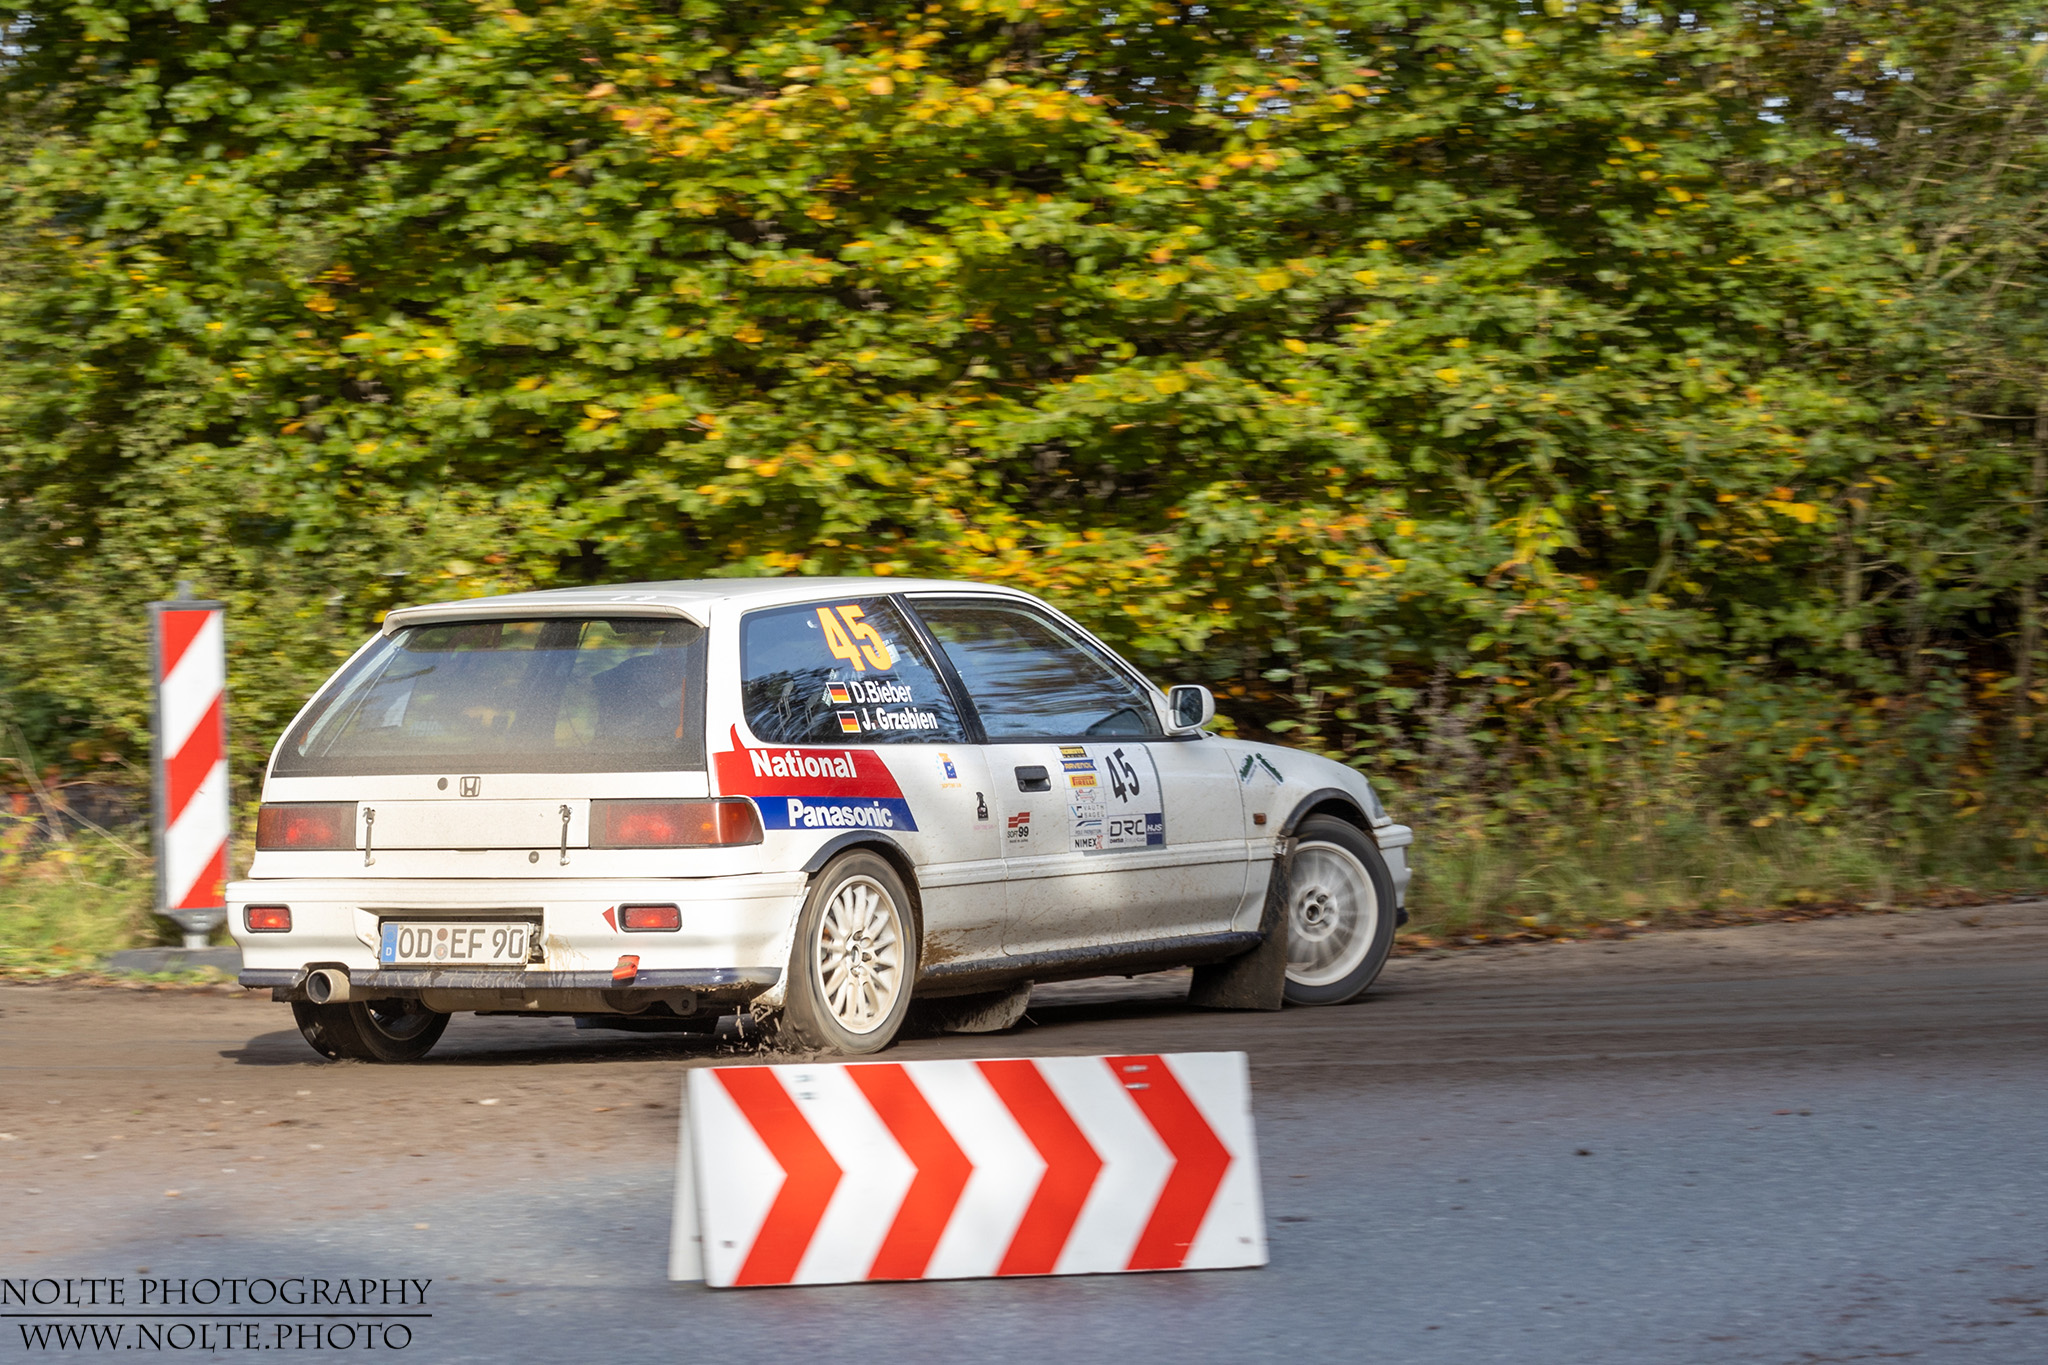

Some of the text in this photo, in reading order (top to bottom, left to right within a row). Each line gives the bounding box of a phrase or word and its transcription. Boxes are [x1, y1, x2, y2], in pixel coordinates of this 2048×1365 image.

[816, 604, 892, 671] 45
[849, 681, 913, 703] D.Bieber
[862, 707, 938, 731] J. Grzebien
[749, 750, 857, 778] National
[1105, 748, 1139, 803] 45
[787, 798, 893, 828] Panasonic
[1110, 820, 1145, 837] DRC
[1147, 823, 1163, 831] HJS
[385, 947, 392, 956] D
[399, 928, 524, 958] OD EF 90
